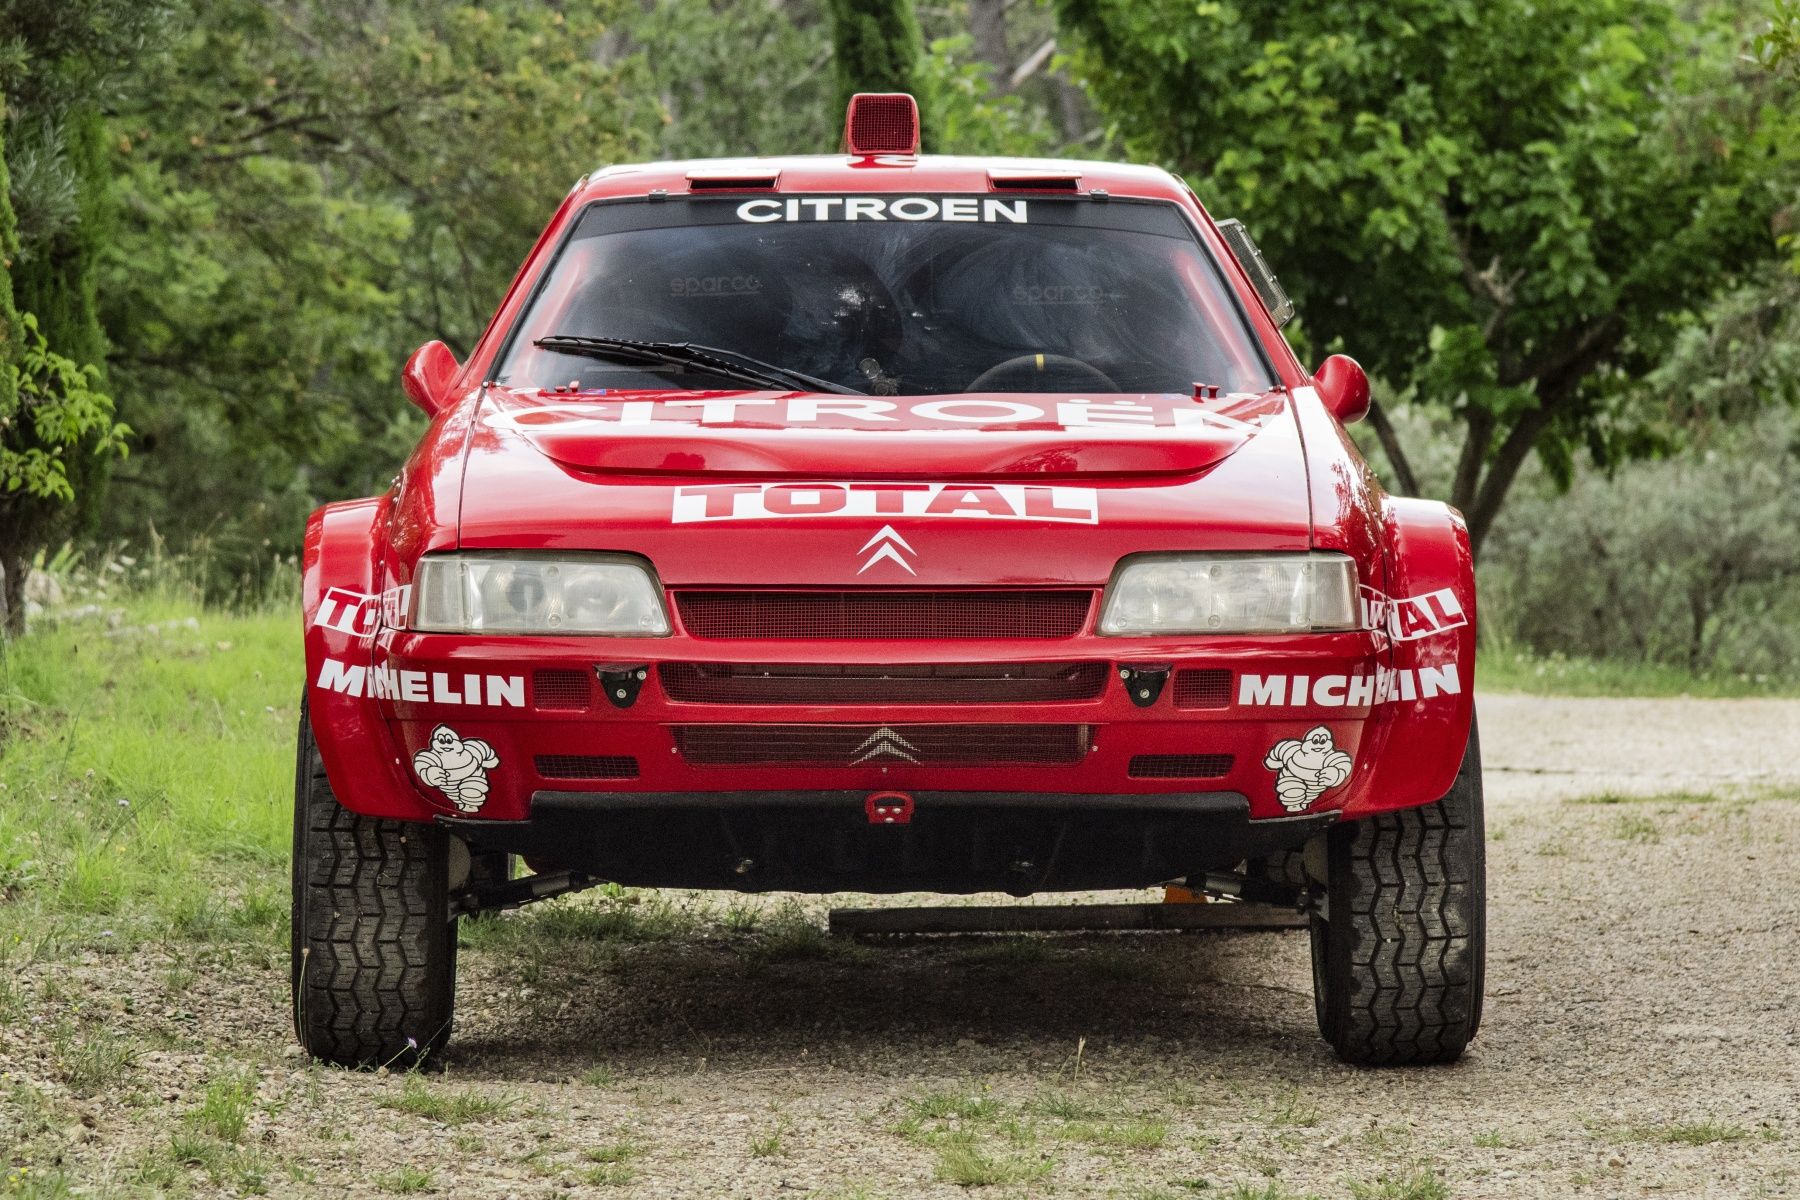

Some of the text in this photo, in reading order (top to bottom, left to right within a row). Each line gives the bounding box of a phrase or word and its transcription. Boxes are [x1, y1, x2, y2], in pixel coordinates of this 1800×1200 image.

[736, 198, 1028, 223] CITROEN
[670, 275, 761, 297] sparco
[674, 483, 1097, 522] TOTAL
